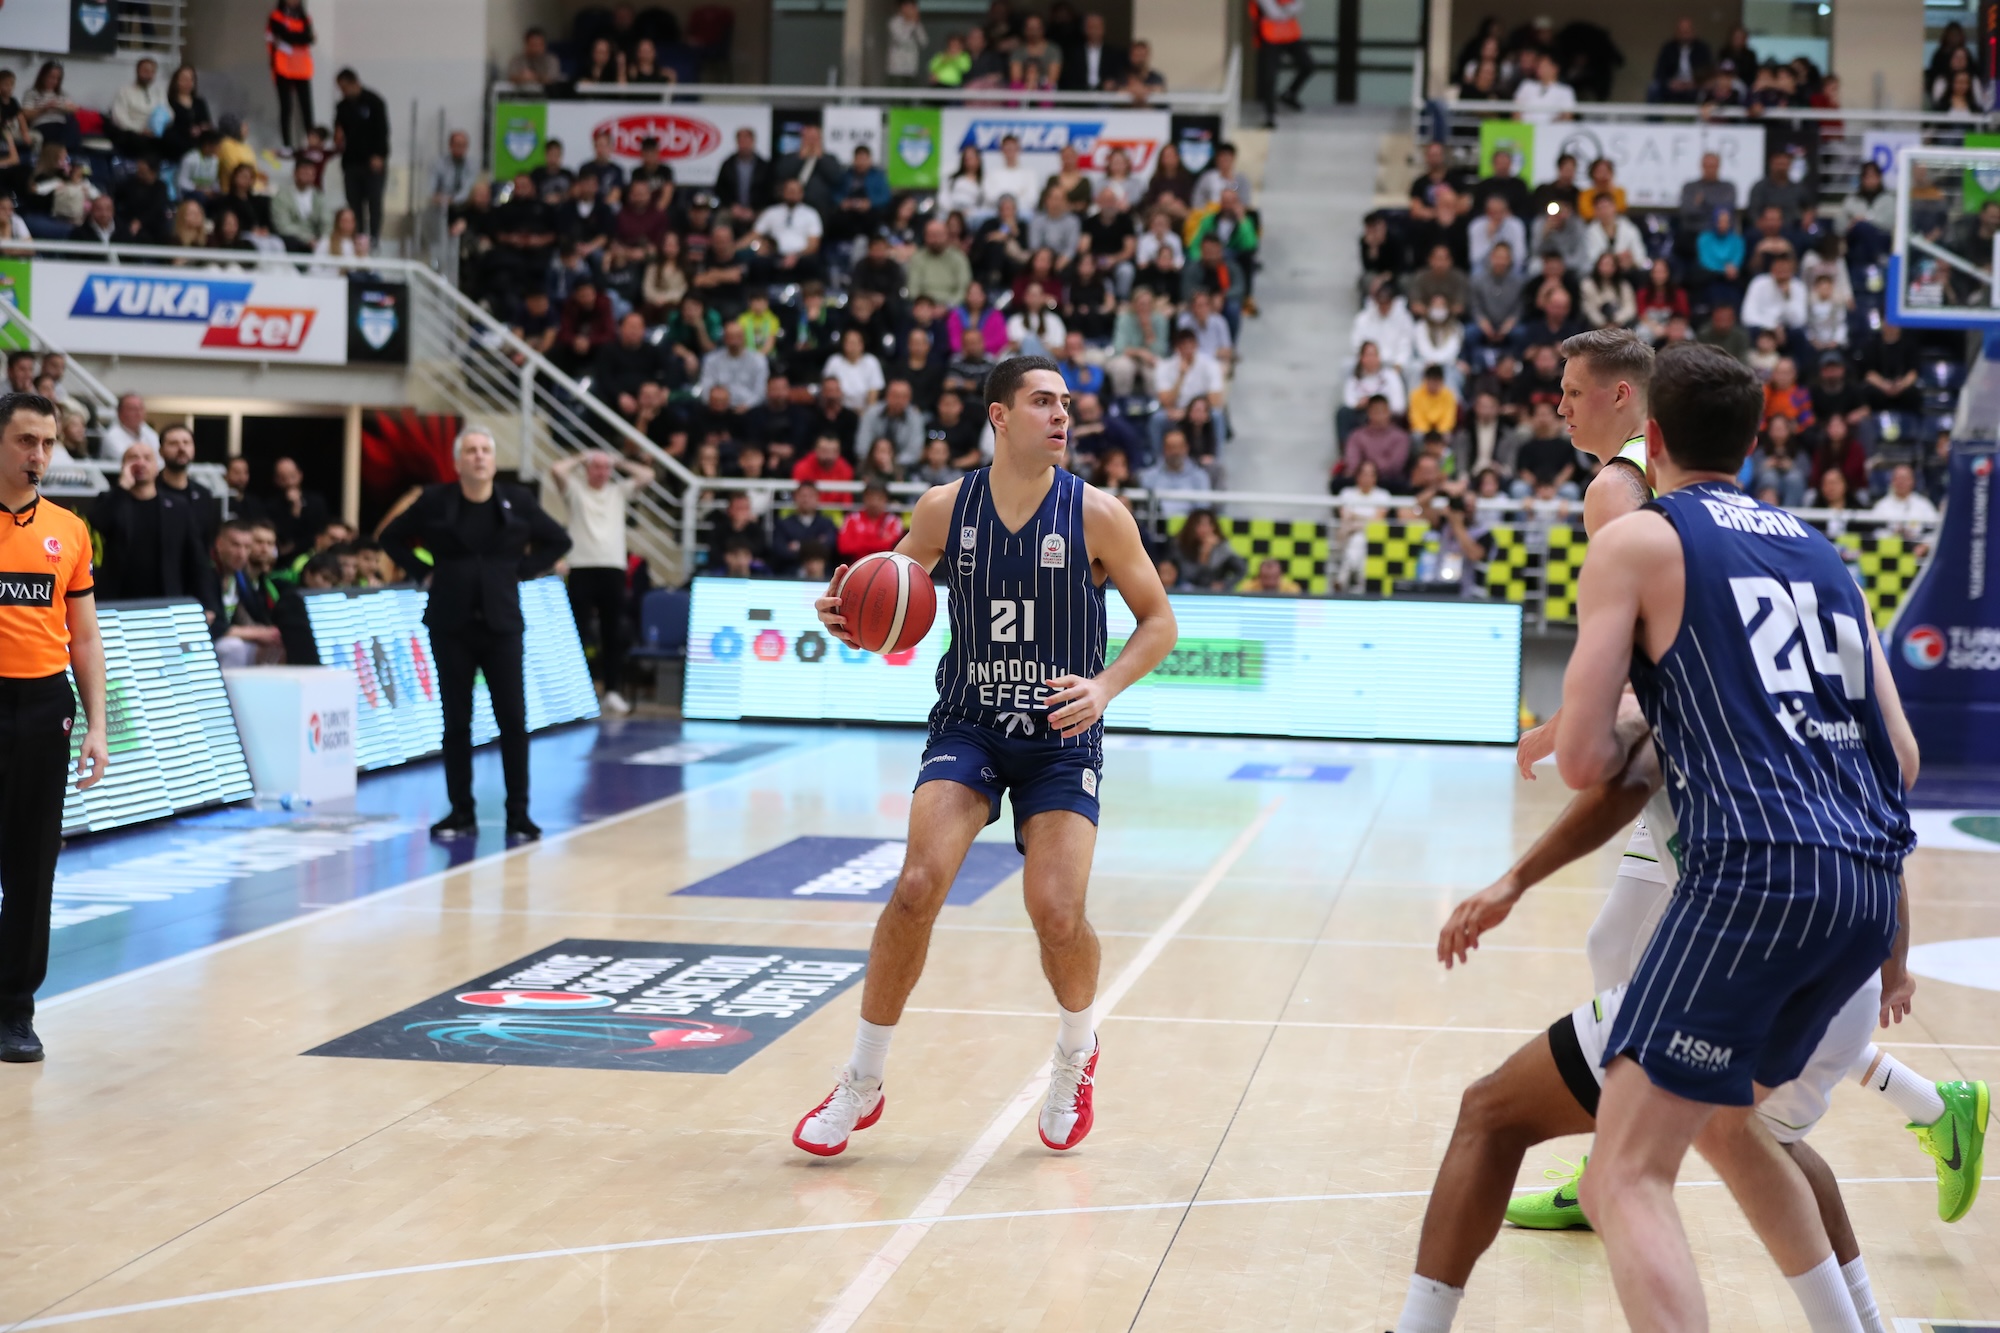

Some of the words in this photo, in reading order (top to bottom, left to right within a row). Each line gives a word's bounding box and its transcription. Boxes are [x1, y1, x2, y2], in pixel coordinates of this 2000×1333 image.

[92, 279, 210, 318] YUKA
[238, 311, 305, 347] tel
[1700, 499, 1809, 538] ERCAN
[990, 599, 1035, 643] 21
[1728, 576, 1866, 700] 24
[979, 684, 1050, 710] EFES
[613, 954, 783, 1015] BASKETBOL
[711, 979, 837, 1019] SÜPER
[1669, 1030, 1733, 1069] HSM
